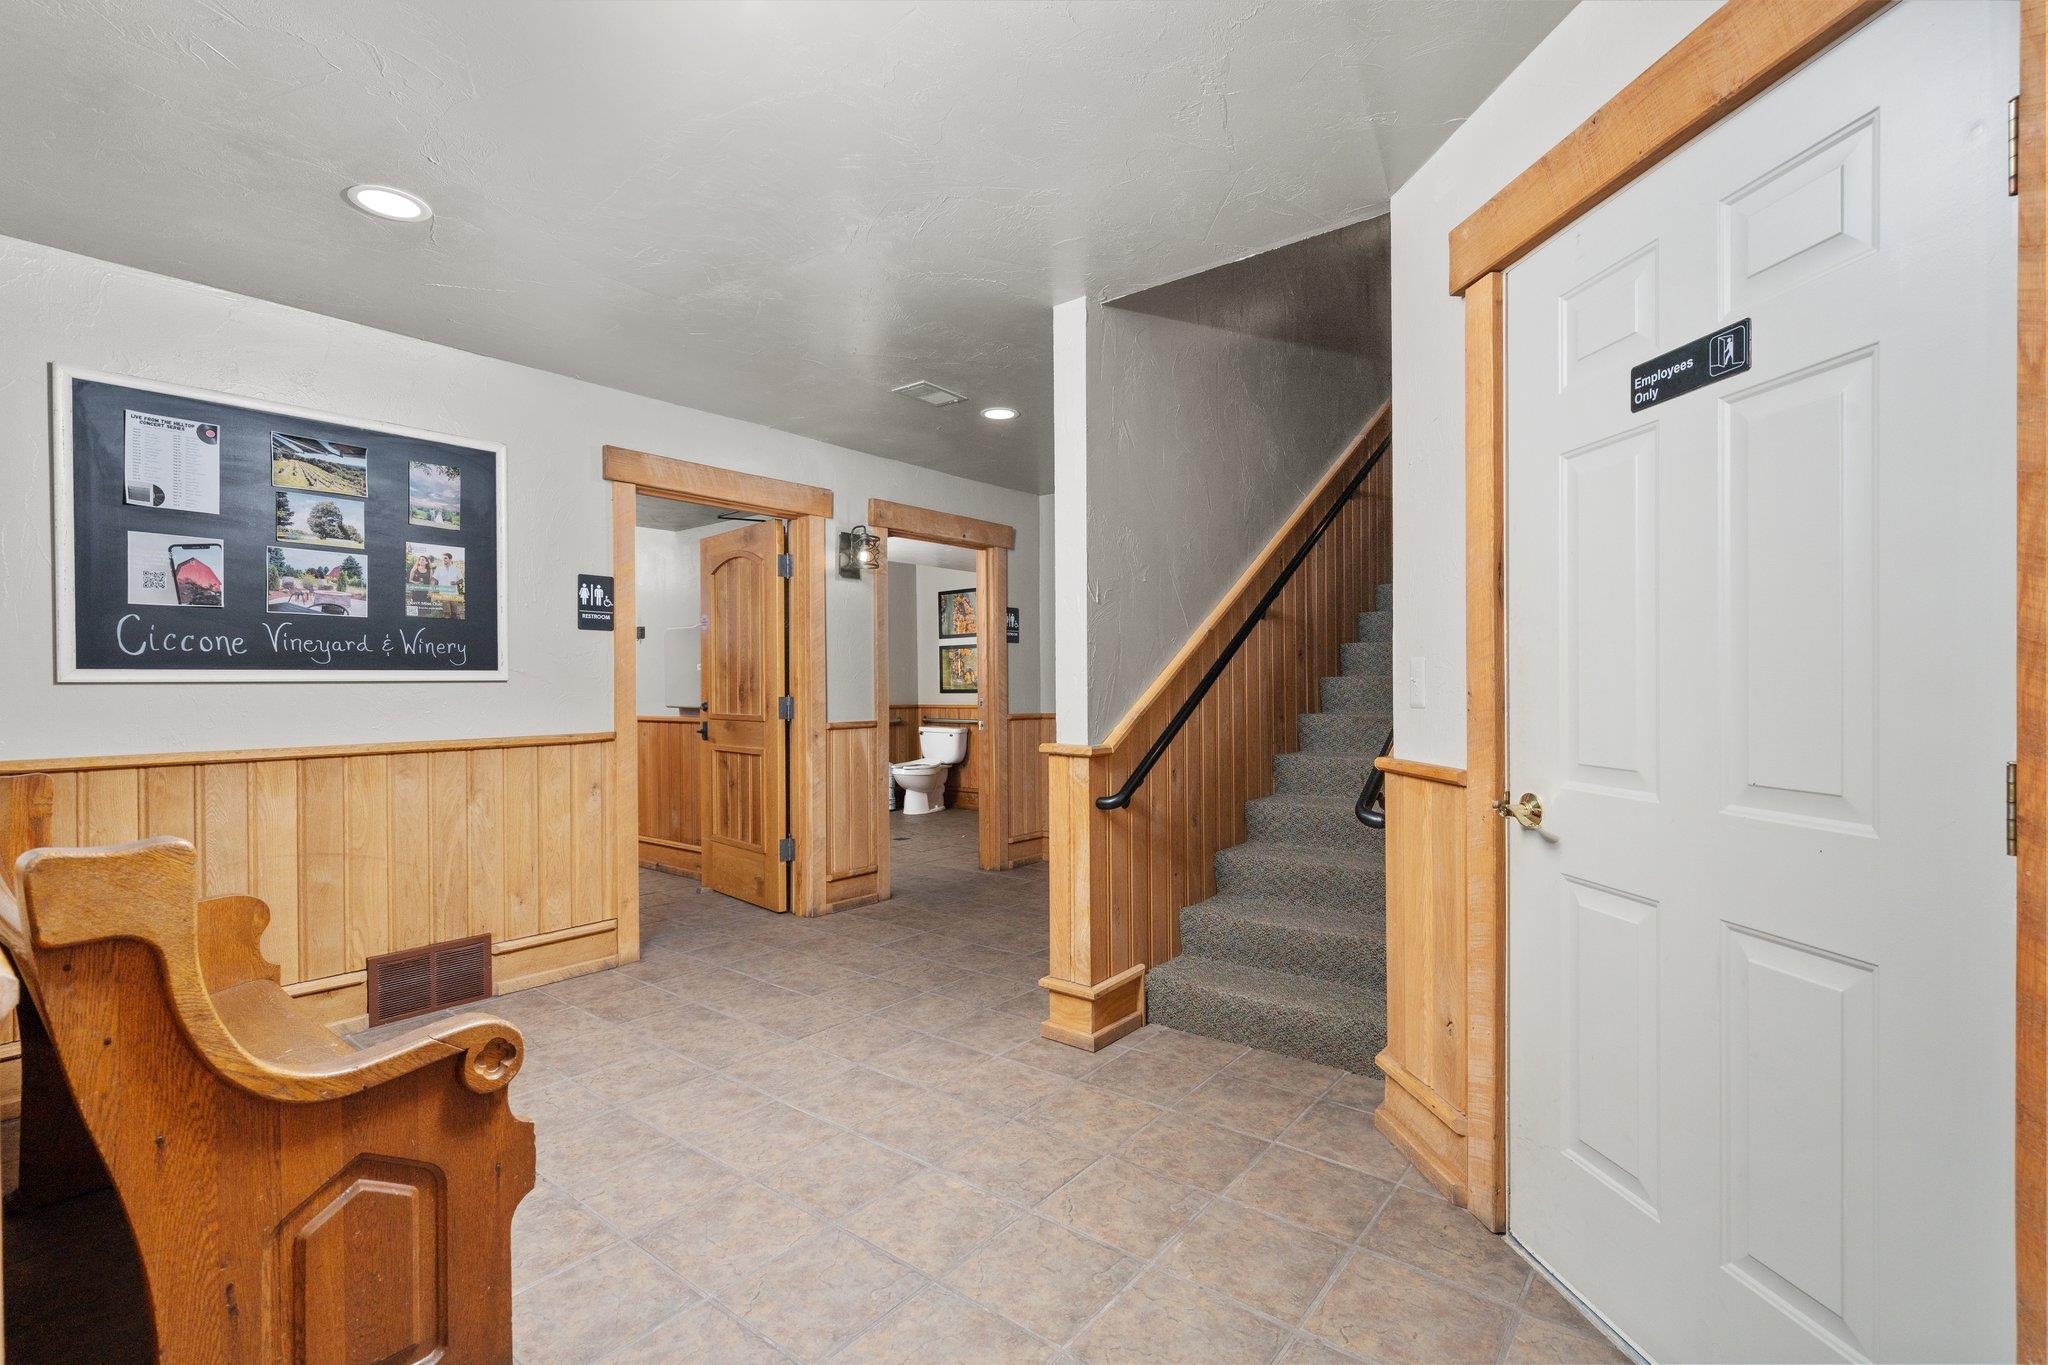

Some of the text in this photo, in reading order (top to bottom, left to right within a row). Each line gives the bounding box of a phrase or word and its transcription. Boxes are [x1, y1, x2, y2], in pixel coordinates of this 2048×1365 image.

[1634, 358, 1694, 389] Employees
[1634, 387, 1659, 404] Only
[140, 420, 164, 428] CONCERT
[116, 614, 248, 656] Ciccone
[262, 622, 373, 664] Vineyard
[399, 627, 467, 666] Winery
